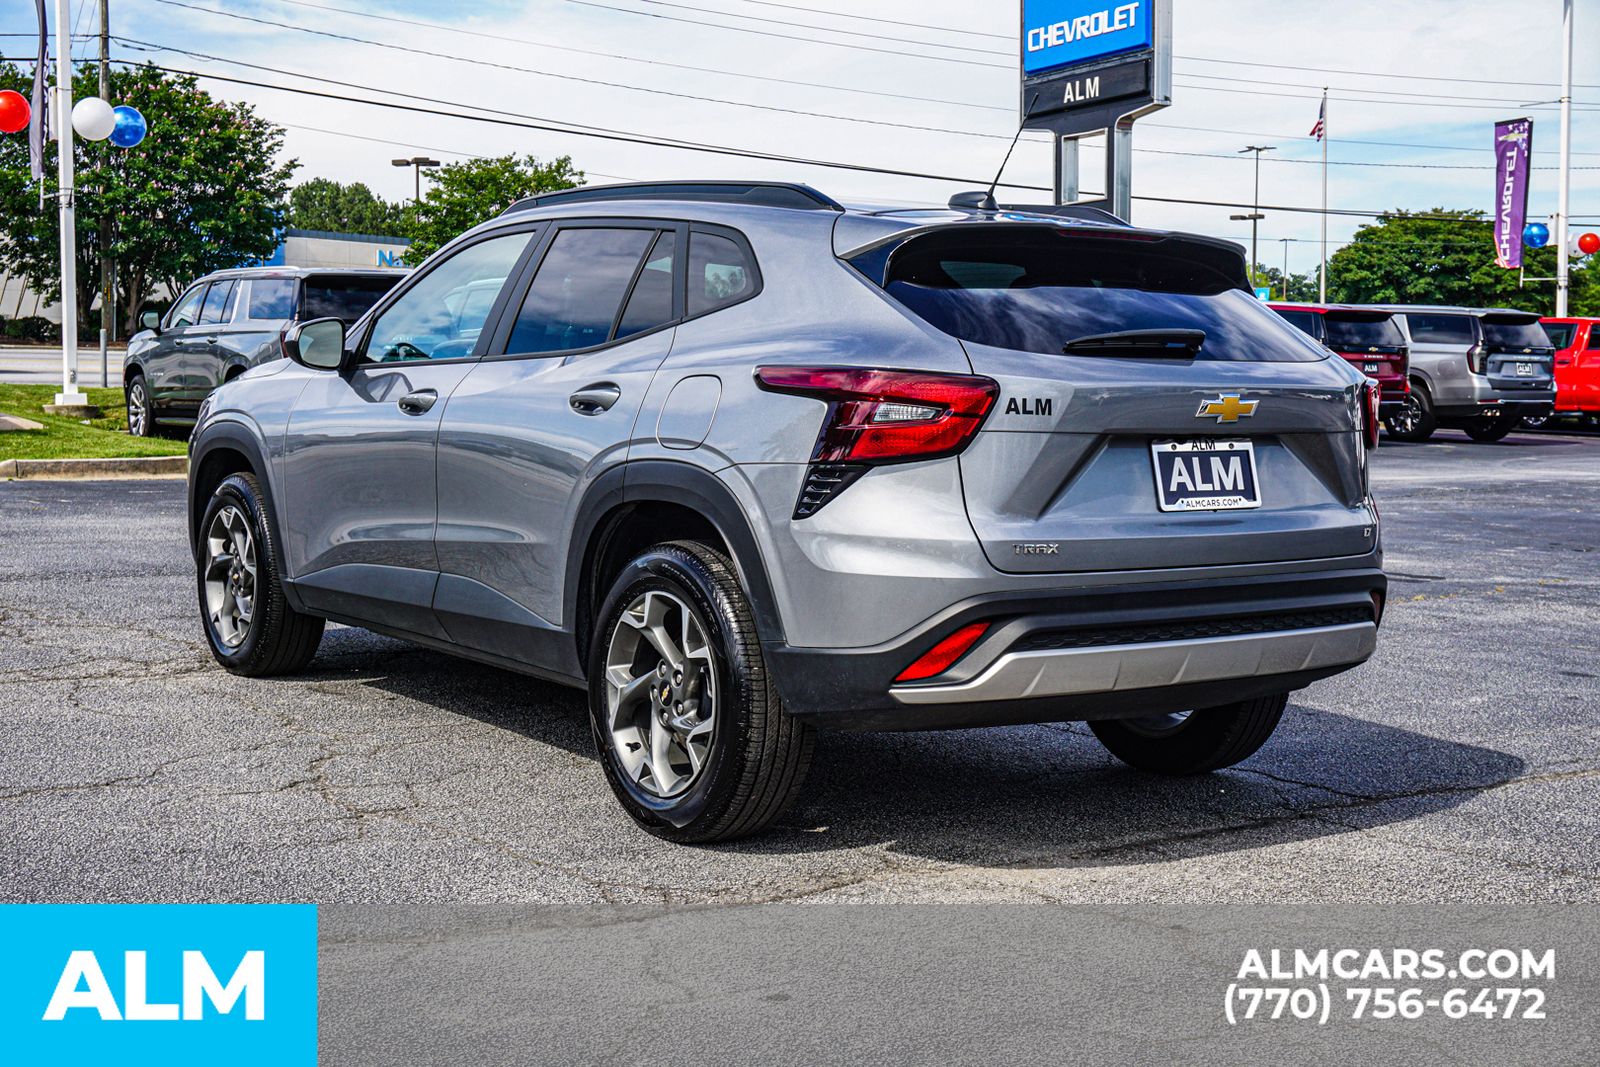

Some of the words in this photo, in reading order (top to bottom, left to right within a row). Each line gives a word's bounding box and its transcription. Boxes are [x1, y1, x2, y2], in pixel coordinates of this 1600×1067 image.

[1027, 2, 1140, 52] CHEVROLET
[1063, 76, 1099, 104] ALM
[1500, 147, 1517, 261] CHEVROLET
[1364, 364, 1378, 372] ALM
[1004, 397, 1052, 416] ALM
[1191, 440, 1216, 451] ALM
[1169, 456, 1245, 492] ALM
[1185, 498, 1240, 508] ALMCARS.COM
[1012, 543, 1059, 554] TRAX
